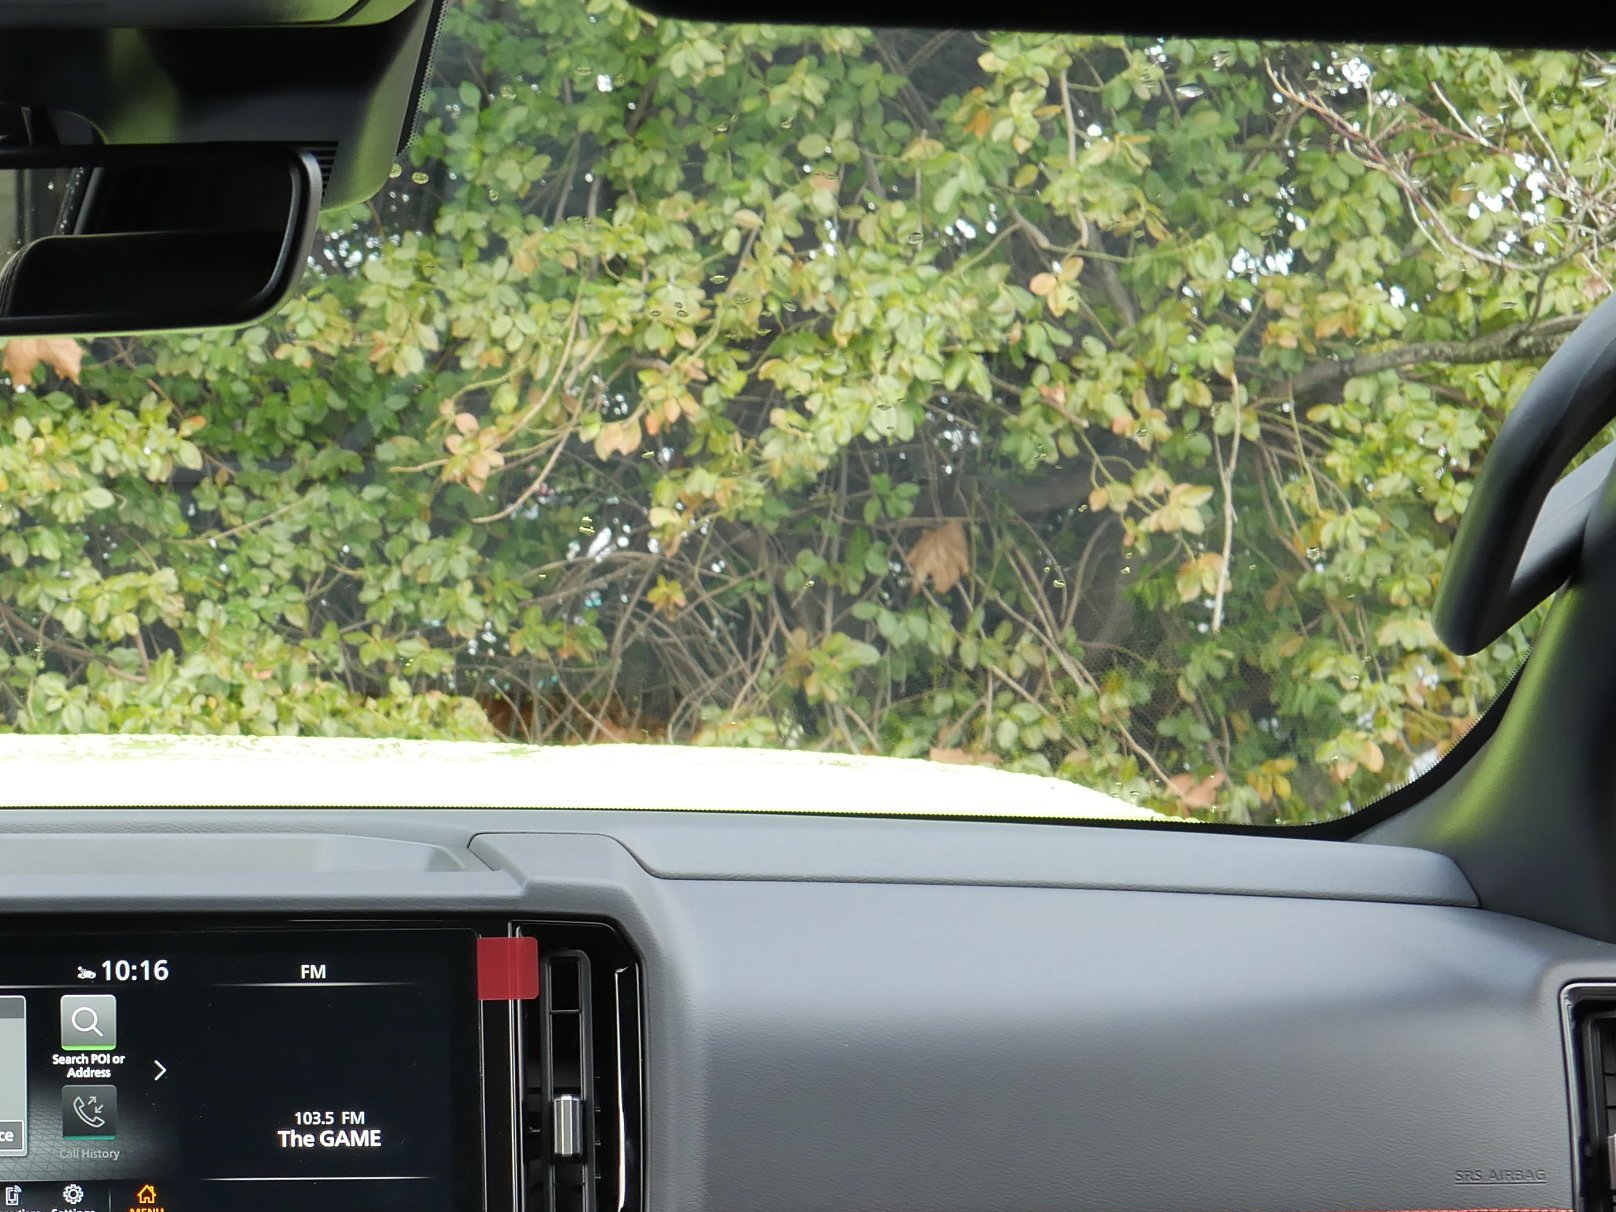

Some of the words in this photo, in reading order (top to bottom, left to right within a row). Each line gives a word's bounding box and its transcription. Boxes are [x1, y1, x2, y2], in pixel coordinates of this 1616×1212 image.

[101, 960, 169, 981] 10:16
[300, 965, 326, 979] FM
[52, 1054, 89, 1065] Search
[91, 1054, 111, 1065] POI
[113, 1056, 125, 1065] or
[67, 1067, 111, 1078] Address
[294, 1112, 334, 1124] 103.5
[342, 1112, 365, 1124] FM
[278, 1130, 315, 1147] The
[319, 1130, 382, 1147] GAME
[60, 1148, 79, 1160] Call
[81, 1148, 120, 1161] History
[1455, 1170, 1483, 1182] SRS
[1489, 1169, 1546, 1182] AIRBAG
